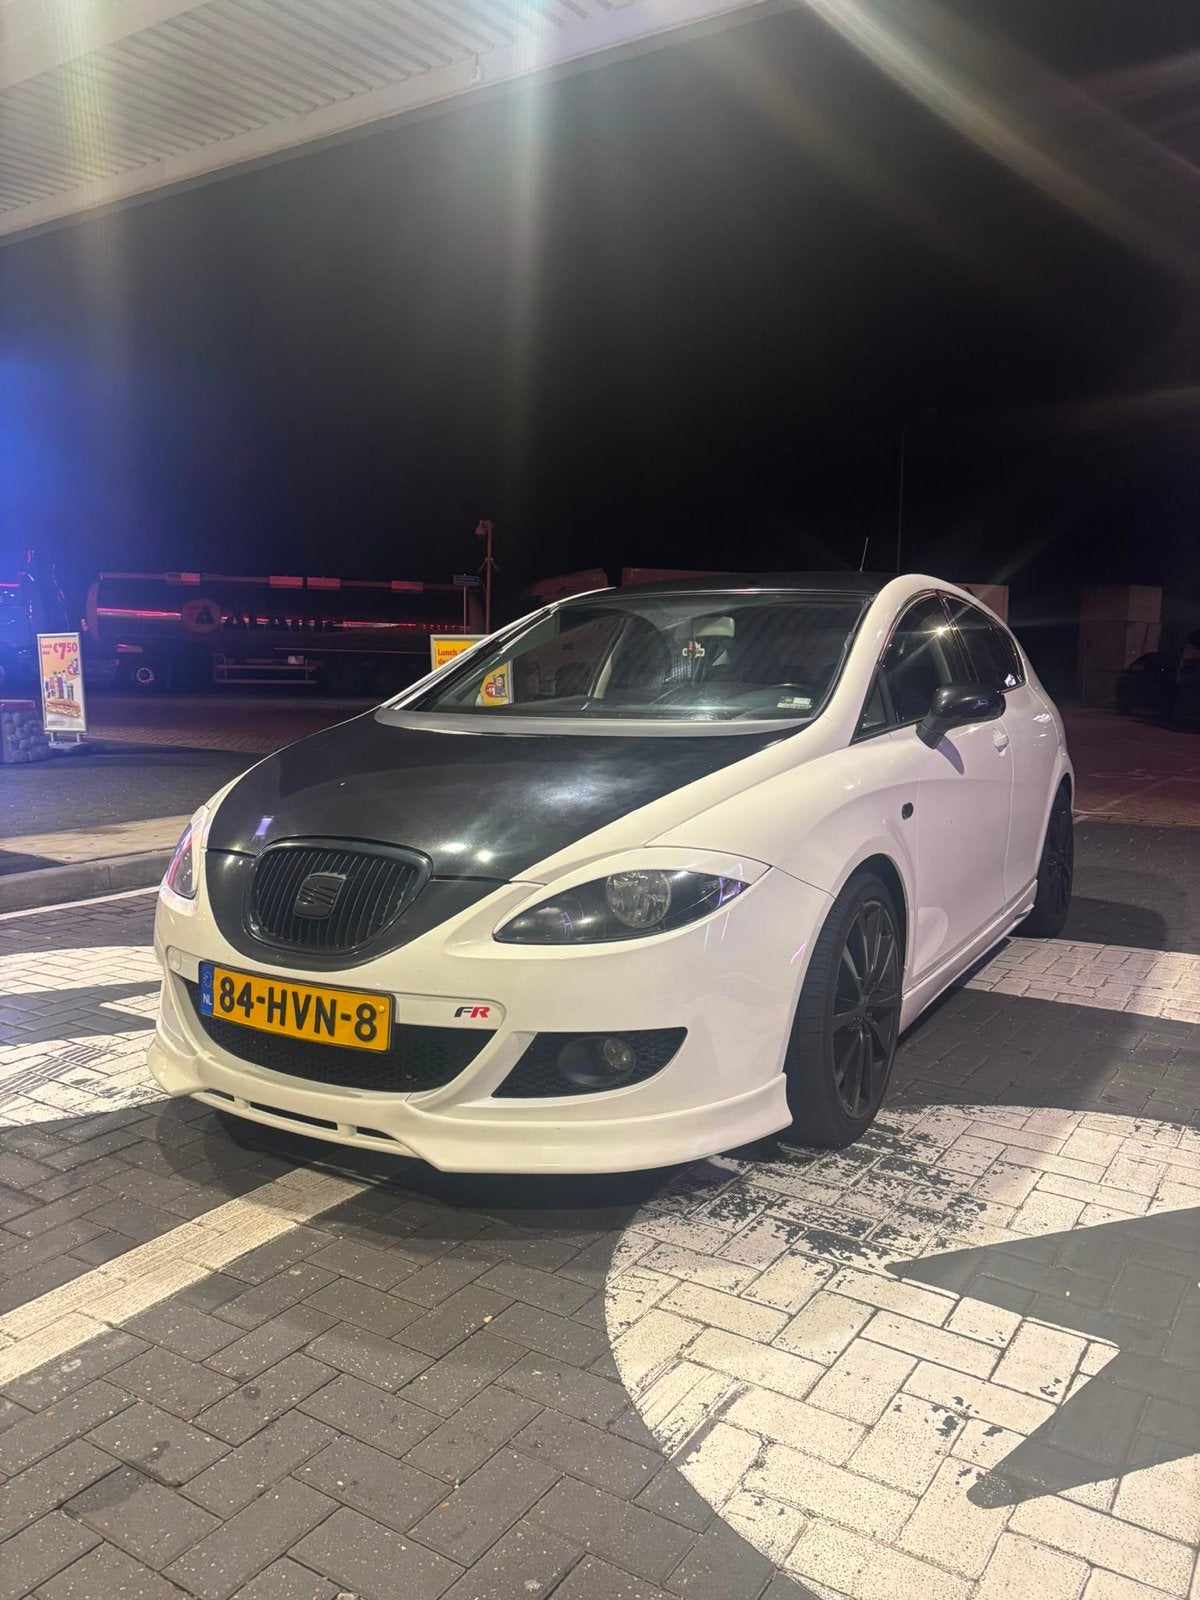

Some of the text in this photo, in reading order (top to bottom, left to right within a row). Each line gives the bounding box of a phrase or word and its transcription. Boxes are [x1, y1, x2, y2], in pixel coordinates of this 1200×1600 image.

[437, 648, 458, 656] Lunch
[203, 993, 213, 1006] NL
[219, 976, 378, 1042] 84-HVN-8
[454, 1007, 490, 1018] FR
